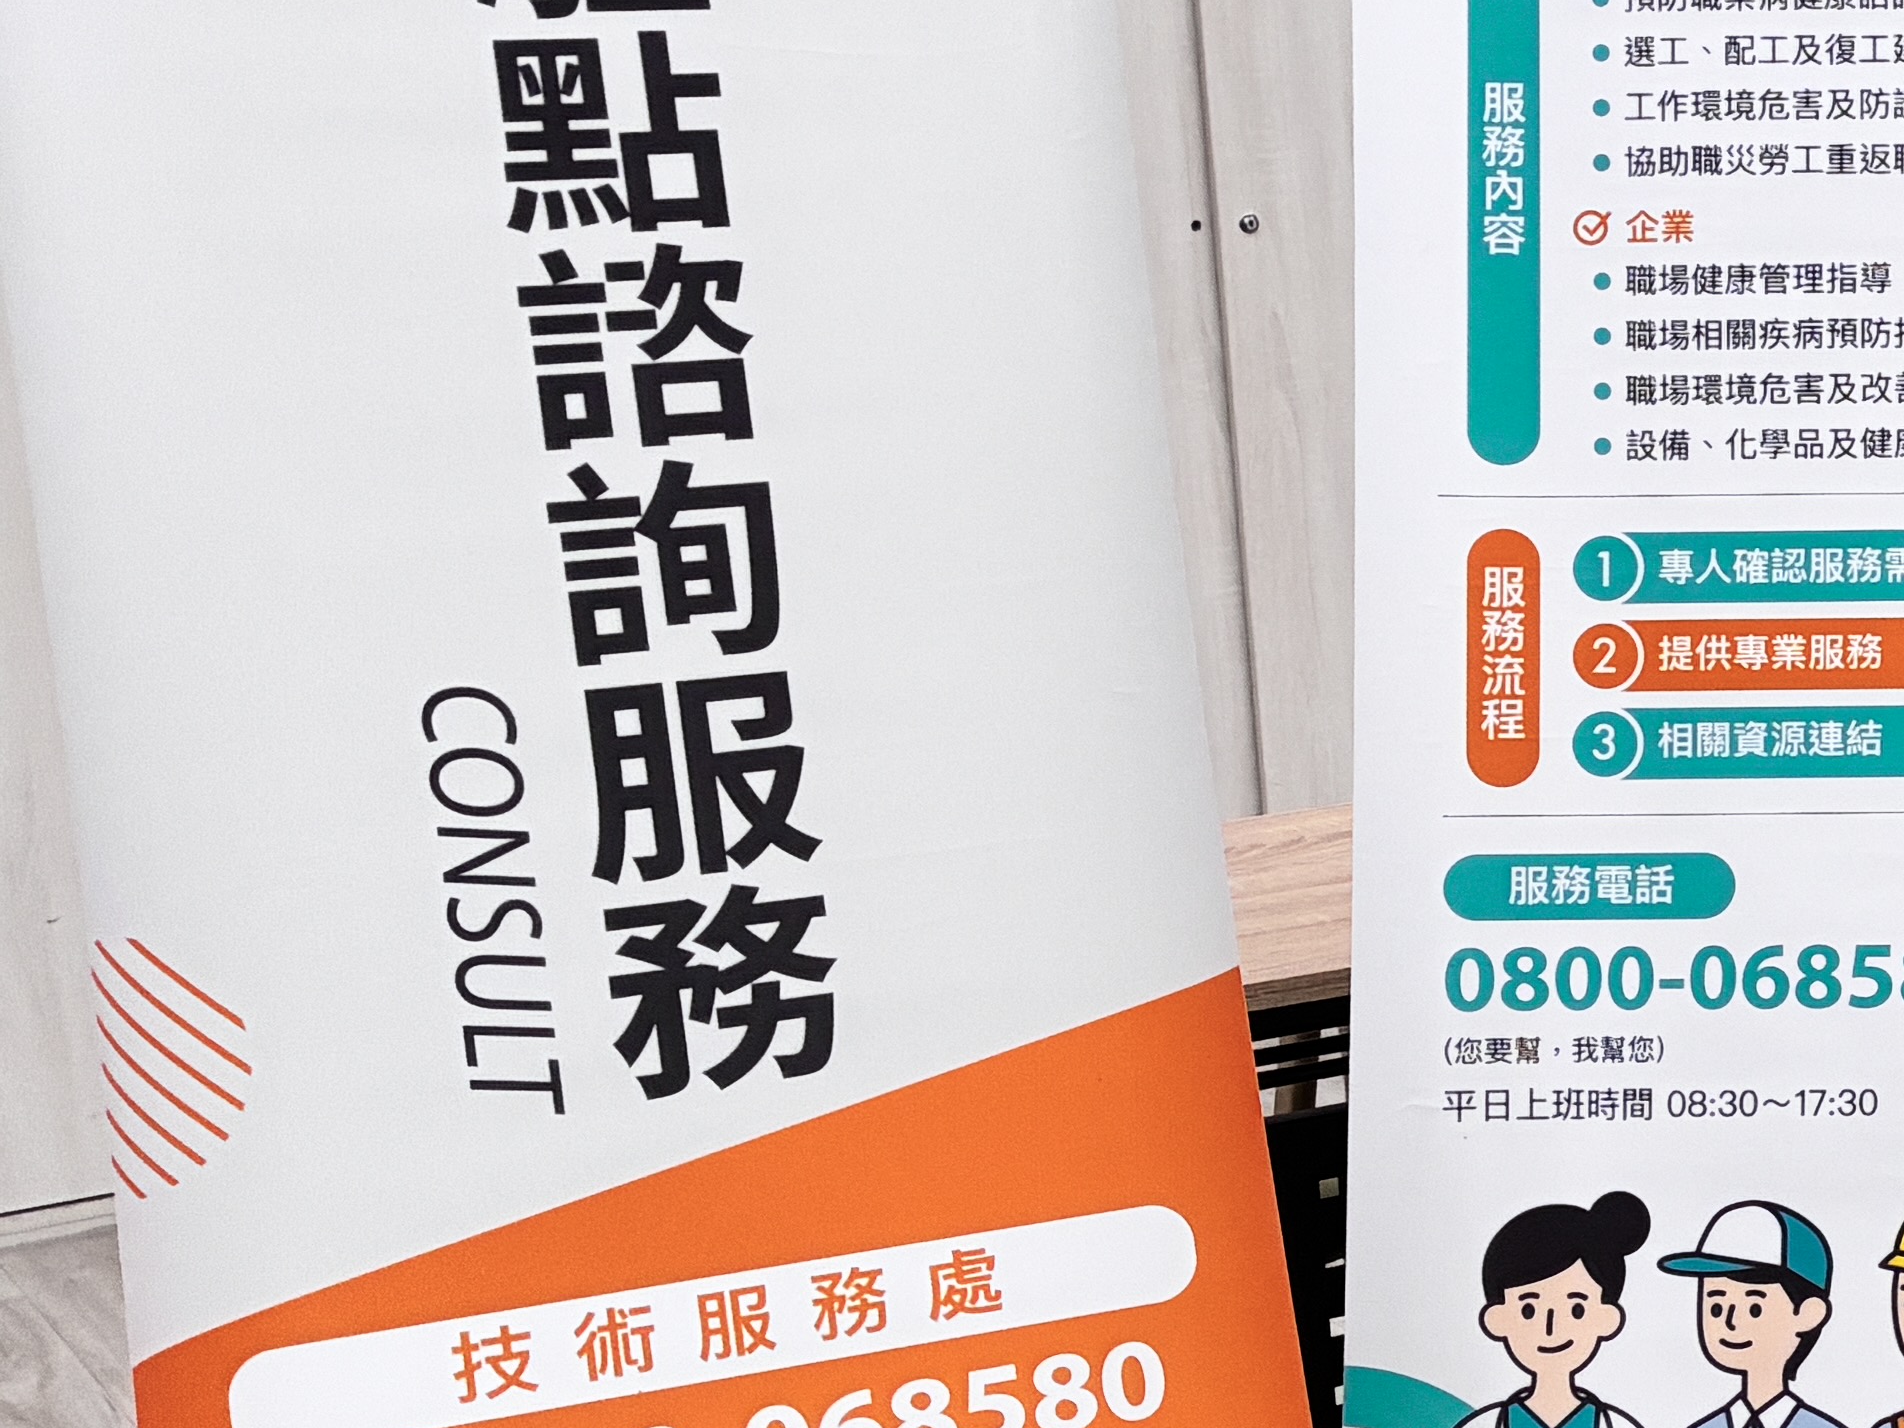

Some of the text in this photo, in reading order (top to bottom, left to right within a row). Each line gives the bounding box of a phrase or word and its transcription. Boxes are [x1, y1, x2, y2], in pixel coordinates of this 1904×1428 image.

[1481, 80, 1528, 259] 服務內容
[1625, 208, 1695, 247] 企業
[1625, 260, 1893, 299] 職場健康管理指導
[1596, 549, 1614, 590] 1
[1481, 565, 1528, 743] 服務流程
[1591, 633, 1885, 676] 2 提供專業服務
[1591, 720, 1884, 763] 3 相關資源連結
[419, 684, 567, 1116] CONSULT
[1507, 865, 1676, 907] 服務電話
[1442, 1087, 1655, 1124] 平日上班時間
[451, 1244, 1005, 1408] 技術服務處
